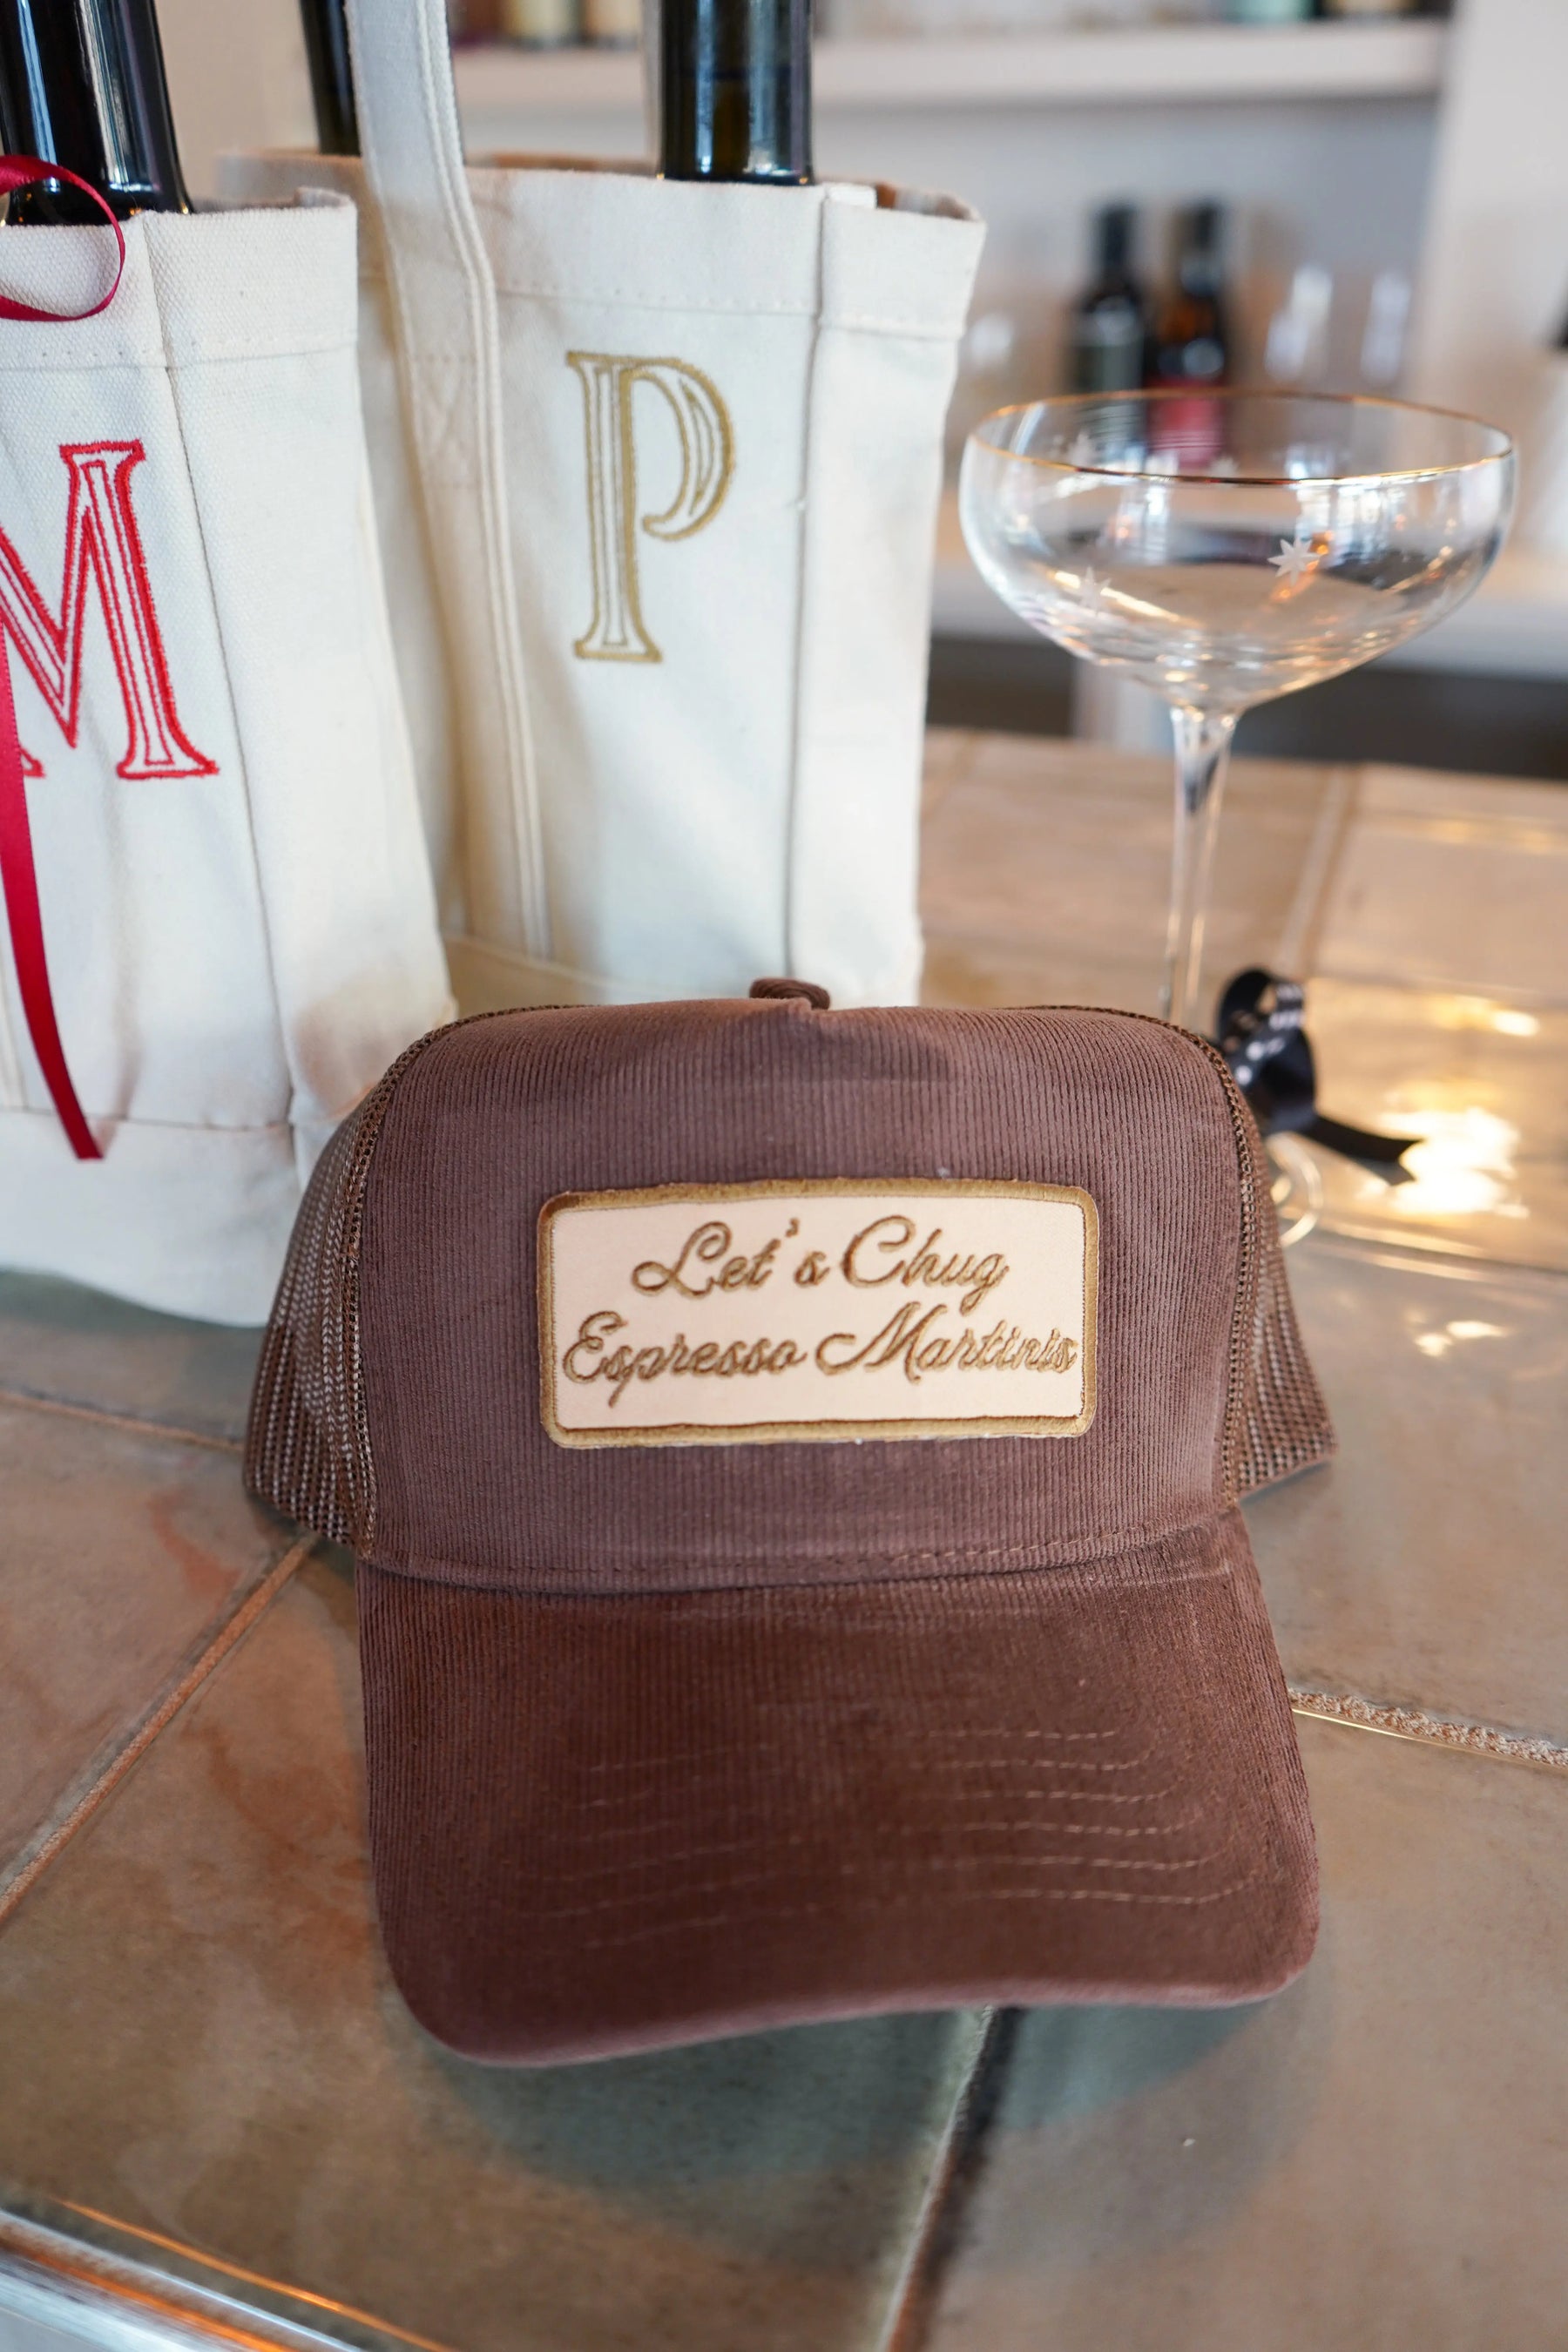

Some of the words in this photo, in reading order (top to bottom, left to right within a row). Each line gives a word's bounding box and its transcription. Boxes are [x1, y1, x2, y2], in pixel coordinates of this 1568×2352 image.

[0, 438, 219, 780] M
[566, 350, 734, 662] P
[561, 1309, 808, 1409] Espresso
[814, 1301, 1078, 1383] Martinis
[631, 1217, 830, 1299] Let's
[840, 1213, 1010, 1315] Chug
